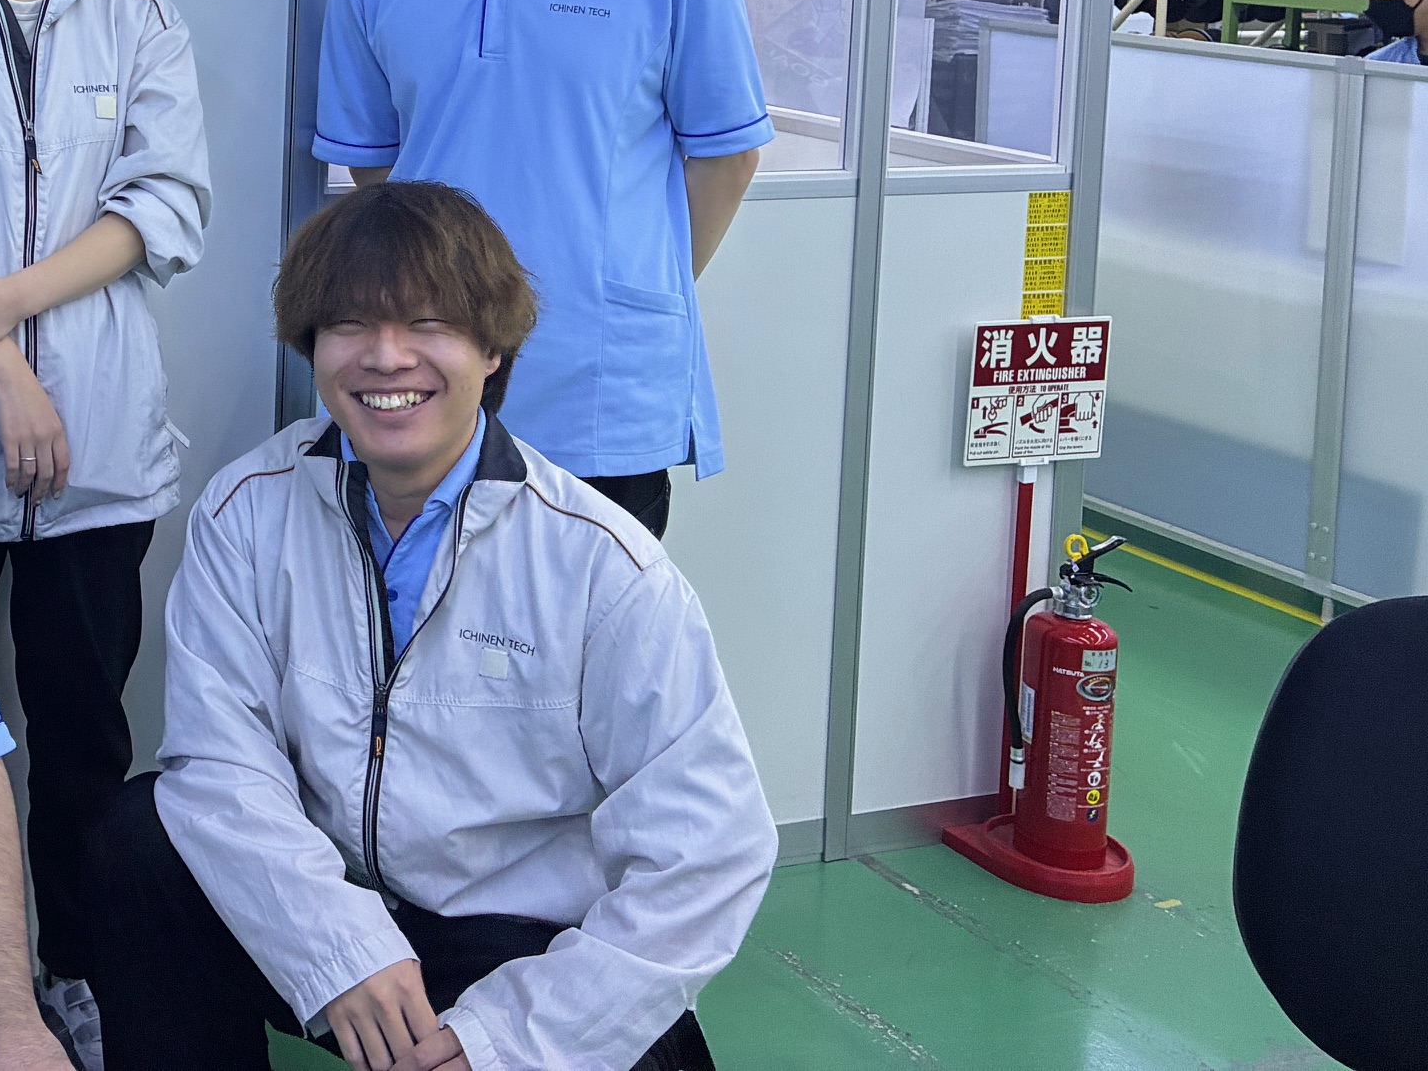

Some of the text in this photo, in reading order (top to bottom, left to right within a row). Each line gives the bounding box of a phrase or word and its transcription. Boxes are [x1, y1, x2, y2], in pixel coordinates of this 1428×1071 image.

[549, 3, 611, 18] ICHINEN TECH
[73, 85, 110, 94] ICHINEN
[980, 326, 1103, 369] 消火器
[993, 366, 1087, 383] FIRE EXTINGUISHER
[1008, 384, 1069, 395] 使用方法 TO OPERATE
[459, 628, 536, 657] ICHINEN TECH
